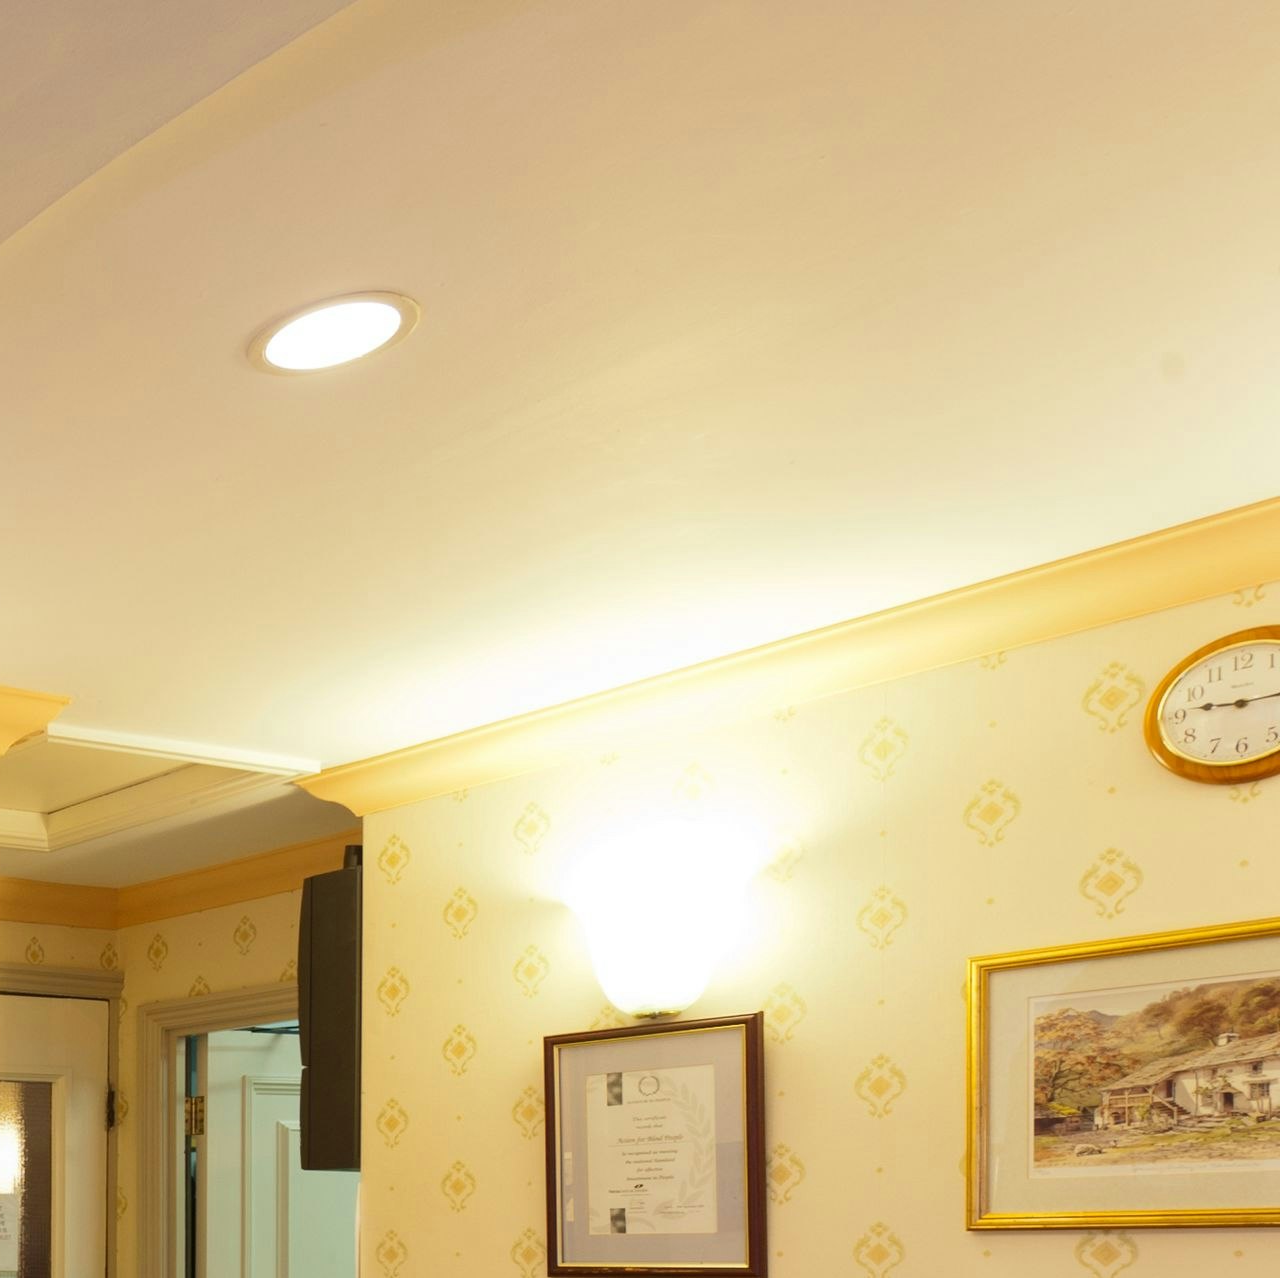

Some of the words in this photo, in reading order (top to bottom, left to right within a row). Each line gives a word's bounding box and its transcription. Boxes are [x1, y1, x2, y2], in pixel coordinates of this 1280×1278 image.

[1233, 653, 1254, 671] 12
[1207, 666, 1223, 683] 11
[1186, 686, 1204, 702] 10
[1174, 709, 1187, 724] 9
[1183, 728, 1197, 744] 8
[1209, 737, 1222, 754] 7
[1235, 736, 1249, 754] 6
